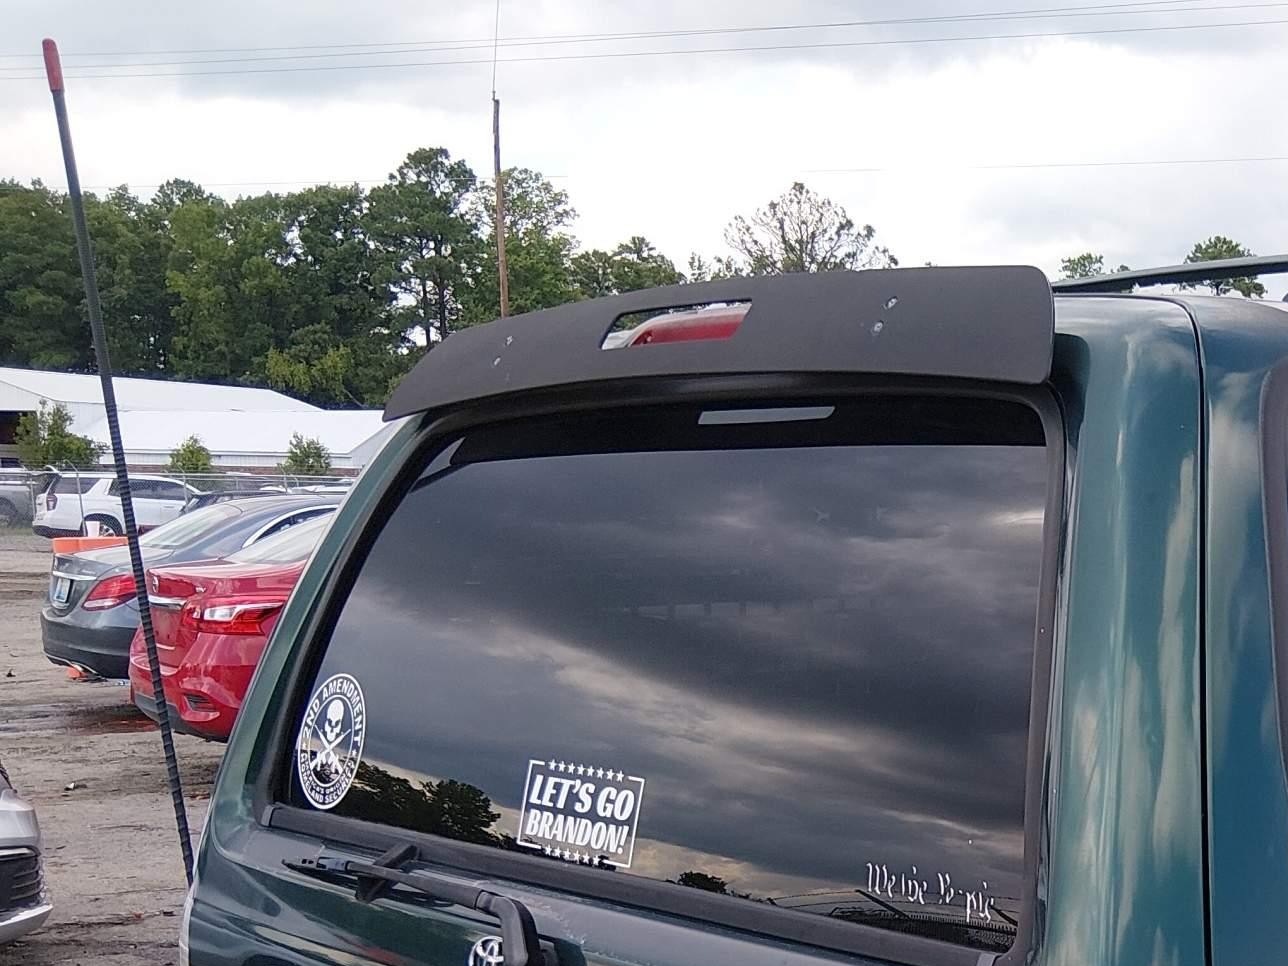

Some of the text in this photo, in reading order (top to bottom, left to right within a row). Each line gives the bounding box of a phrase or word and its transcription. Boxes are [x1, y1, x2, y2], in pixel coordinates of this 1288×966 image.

[302, 678, 364, 746] 2ND AMENDMENT
[529, 774, 635, 821] LET'S GO
[525, 809, 629, 855] BRANDON!
[938, 872, 995, 923] Peple
